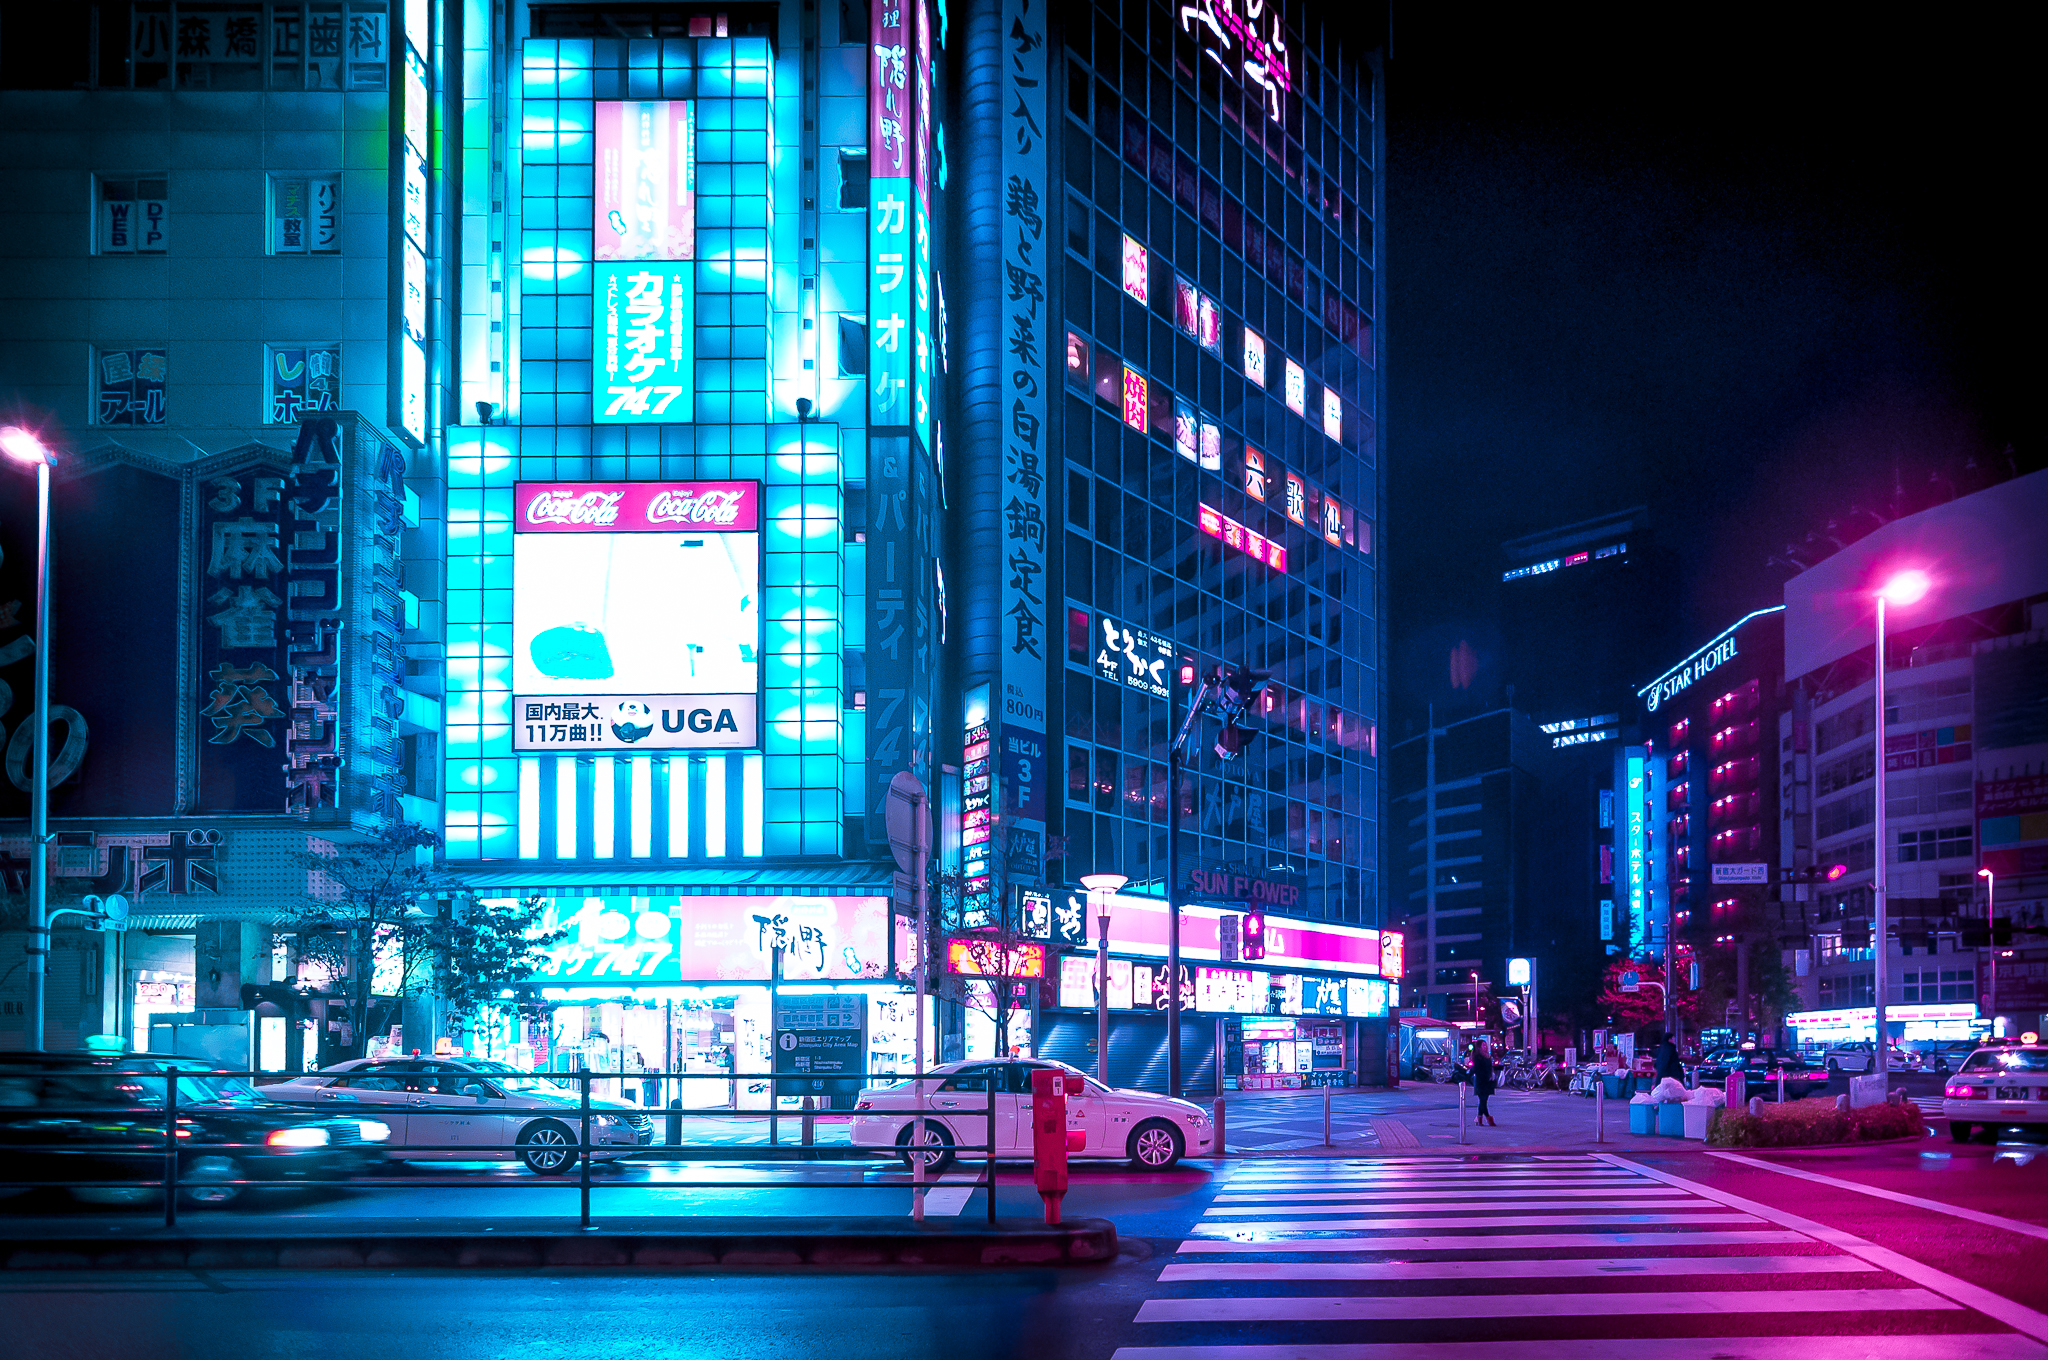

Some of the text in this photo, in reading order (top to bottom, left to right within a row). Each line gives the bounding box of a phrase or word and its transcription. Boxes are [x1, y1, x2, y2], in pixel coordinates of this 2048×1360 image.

[134, 15, 381, 58] 小森矯正歯科
[110, 204, 129, 246] WEB
[147, 203, 163, 245] DTP
[284, 219, 301, 246] 教室
[319, 184, 336, 245] パソコン
[875, 194, 905, 413] カラオケ
[624, 271, 665, 383] カラオケ
[604, 386, 682, 415] 747
[1005, 174, 1045, 662] 鶏と野菜の白湯鍋定食
[1125, 370, 1145, 432] 焼肉
[208, 478, 284, 512] 3F
[526, 490, 624, 526] Coca-Cola
[646, 489, 745, 526] Coca-Cola
[207, 517, 283, 649] 麻雀
[875, 490, 906, 660] パーティ
[1102, 669, 1119, 682] TEL
[1663, 637, 1739, 701] STAR HOTEL
[661, 708, 738, 733] UGA
[1006, 698, 1043, 722] 800円
[1008, 736, 1041, 808] 当ビル 3F
[1630, 812, 1642, 884] スターホテル
[1191, 869, 1228, 896] SUN
[592, 943, 673, 976] 747
